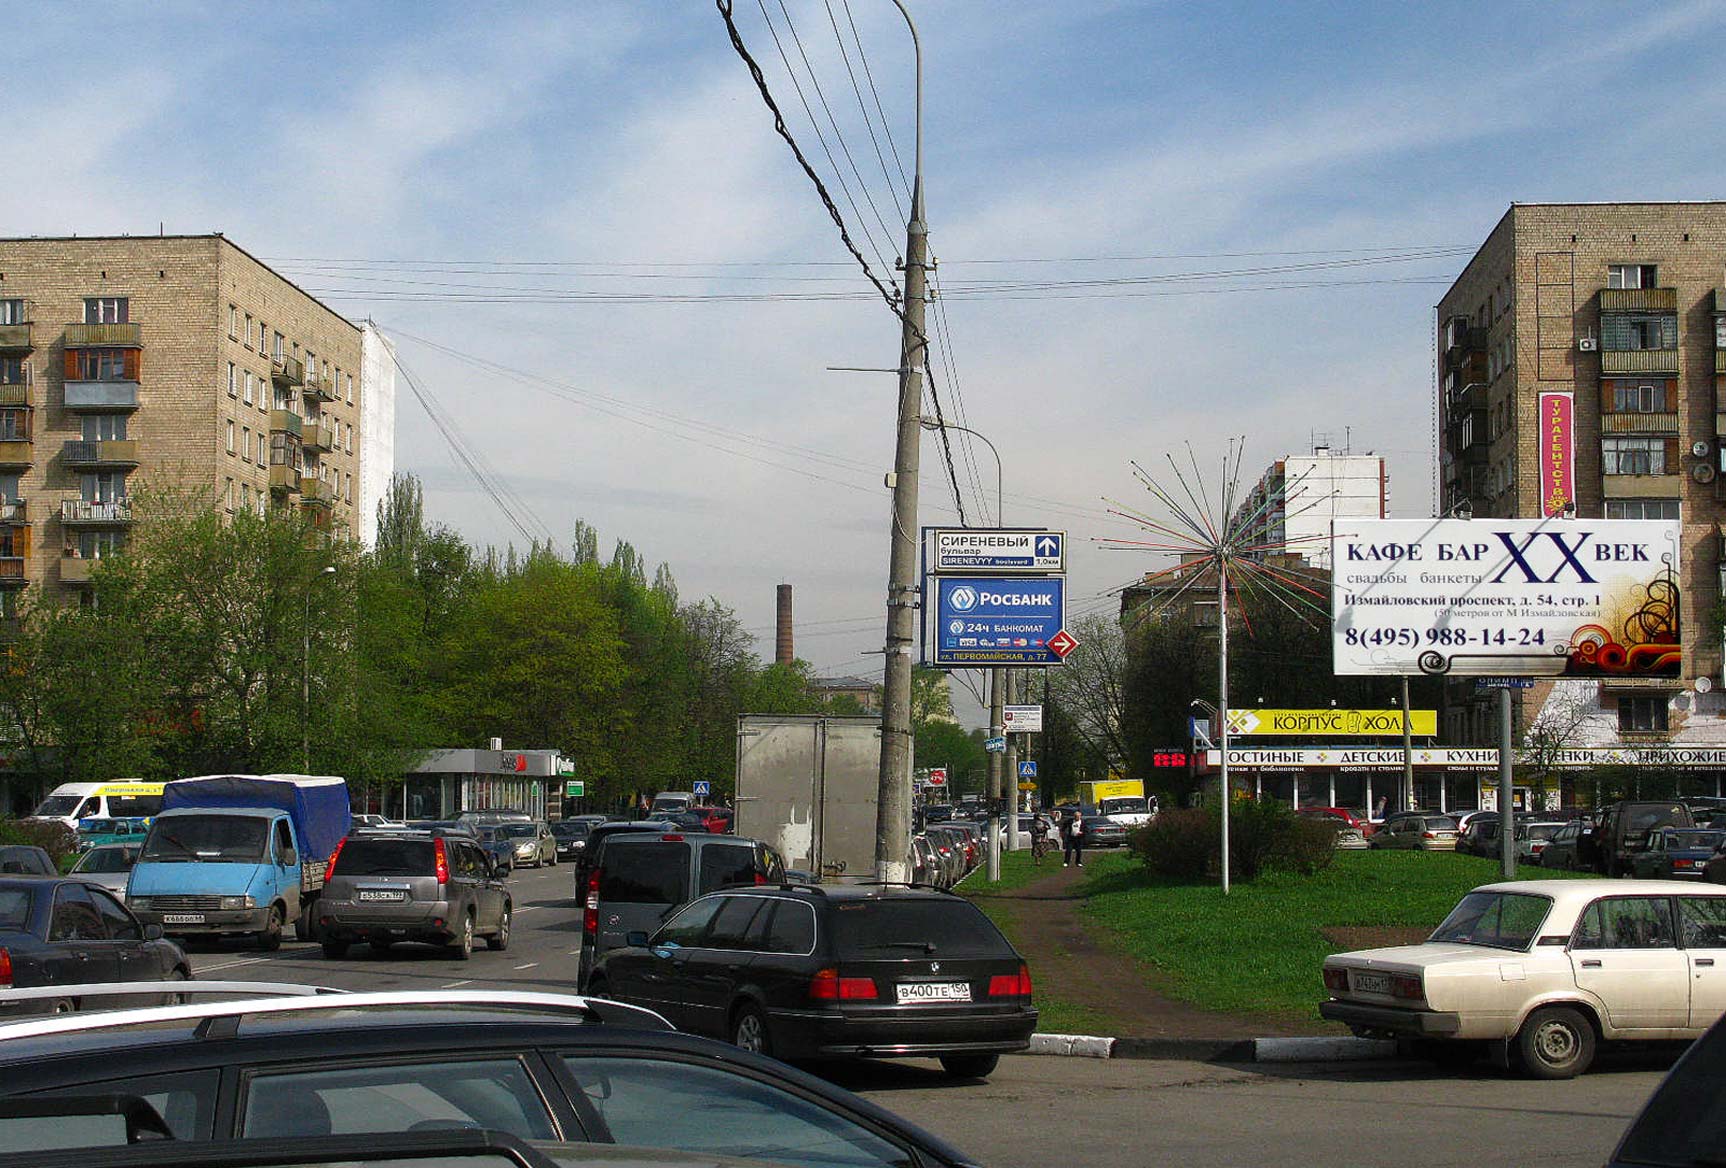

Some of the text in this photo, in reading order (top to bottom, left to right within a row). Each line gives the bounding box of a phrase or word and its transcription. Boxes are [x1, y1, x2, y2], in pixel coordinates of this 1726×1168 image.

[940, 535, 1029, 547] СИРЕНЕВЫЙ
[940, 546, 982, 556] бульвар
[942, 557, 993, 565] SIRENEVYY
[1347, 531, 1650, 584] КАФЕ БАР XX ВЕК
[1346, 571, 1483, 584] свадьбы банкеты
[979, 591, 1053, 606] РОСБАНК
[1344, 594, 1601, 608] Измайловский проспект, д. 54, стр. 1
[1453, 609, 1490, 618] метров
[1492, 609, 1504, 617] от
[1521, 608, 1601, 618] Измайловская)
[966, 623, 1044, 633] 24ч БАНКОМАТ
[1344, 627, 1546, 650] 8(495) 988-14-24
[1037, 653, 1048, 661] 77
[1273, 716, 1342, 730] КОРПУС
[1227, 751, 1305, 763] ОСТИНЫЕ
[1340, 751, 1406, 763] ДЕТСКИЕ
[1446, 750, 1499, 762] КУХНИ
[901, 983, 968, 998] В400ТЕ 150
